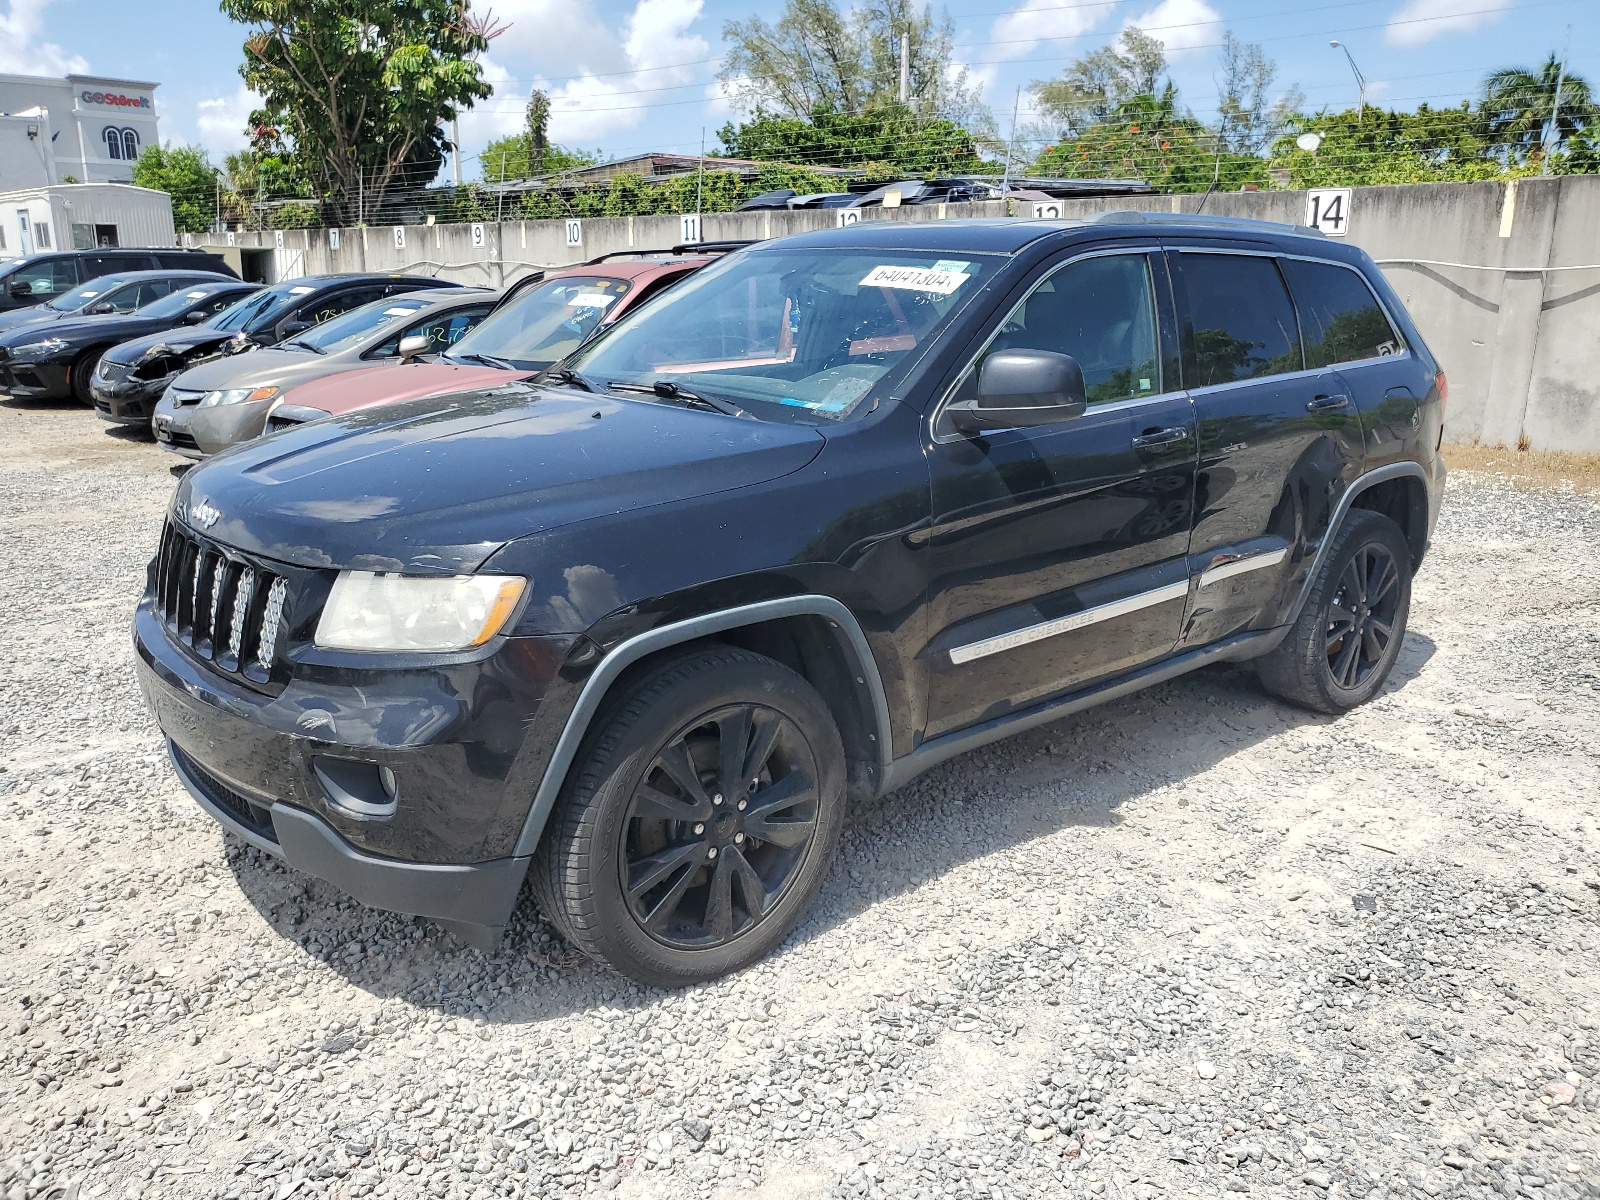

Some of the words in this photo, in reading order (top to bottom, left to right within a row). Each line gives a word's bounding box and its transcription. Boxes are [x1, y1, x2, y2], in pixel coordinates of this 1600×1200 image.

[1309, 195, 1343, 229] 14
[331, 231, 337, 247] 7
[396, 229, 403, 246] 8
[474, 226, 482, 245] 9
[567, 223, 580, 242] 10
[684, 218, 696, 241] 11
[277, 233, 283, 248] 6
[974, 635, 1022, 656] GRAND
[1028, 612, 1095, 640] CHEROKEE
